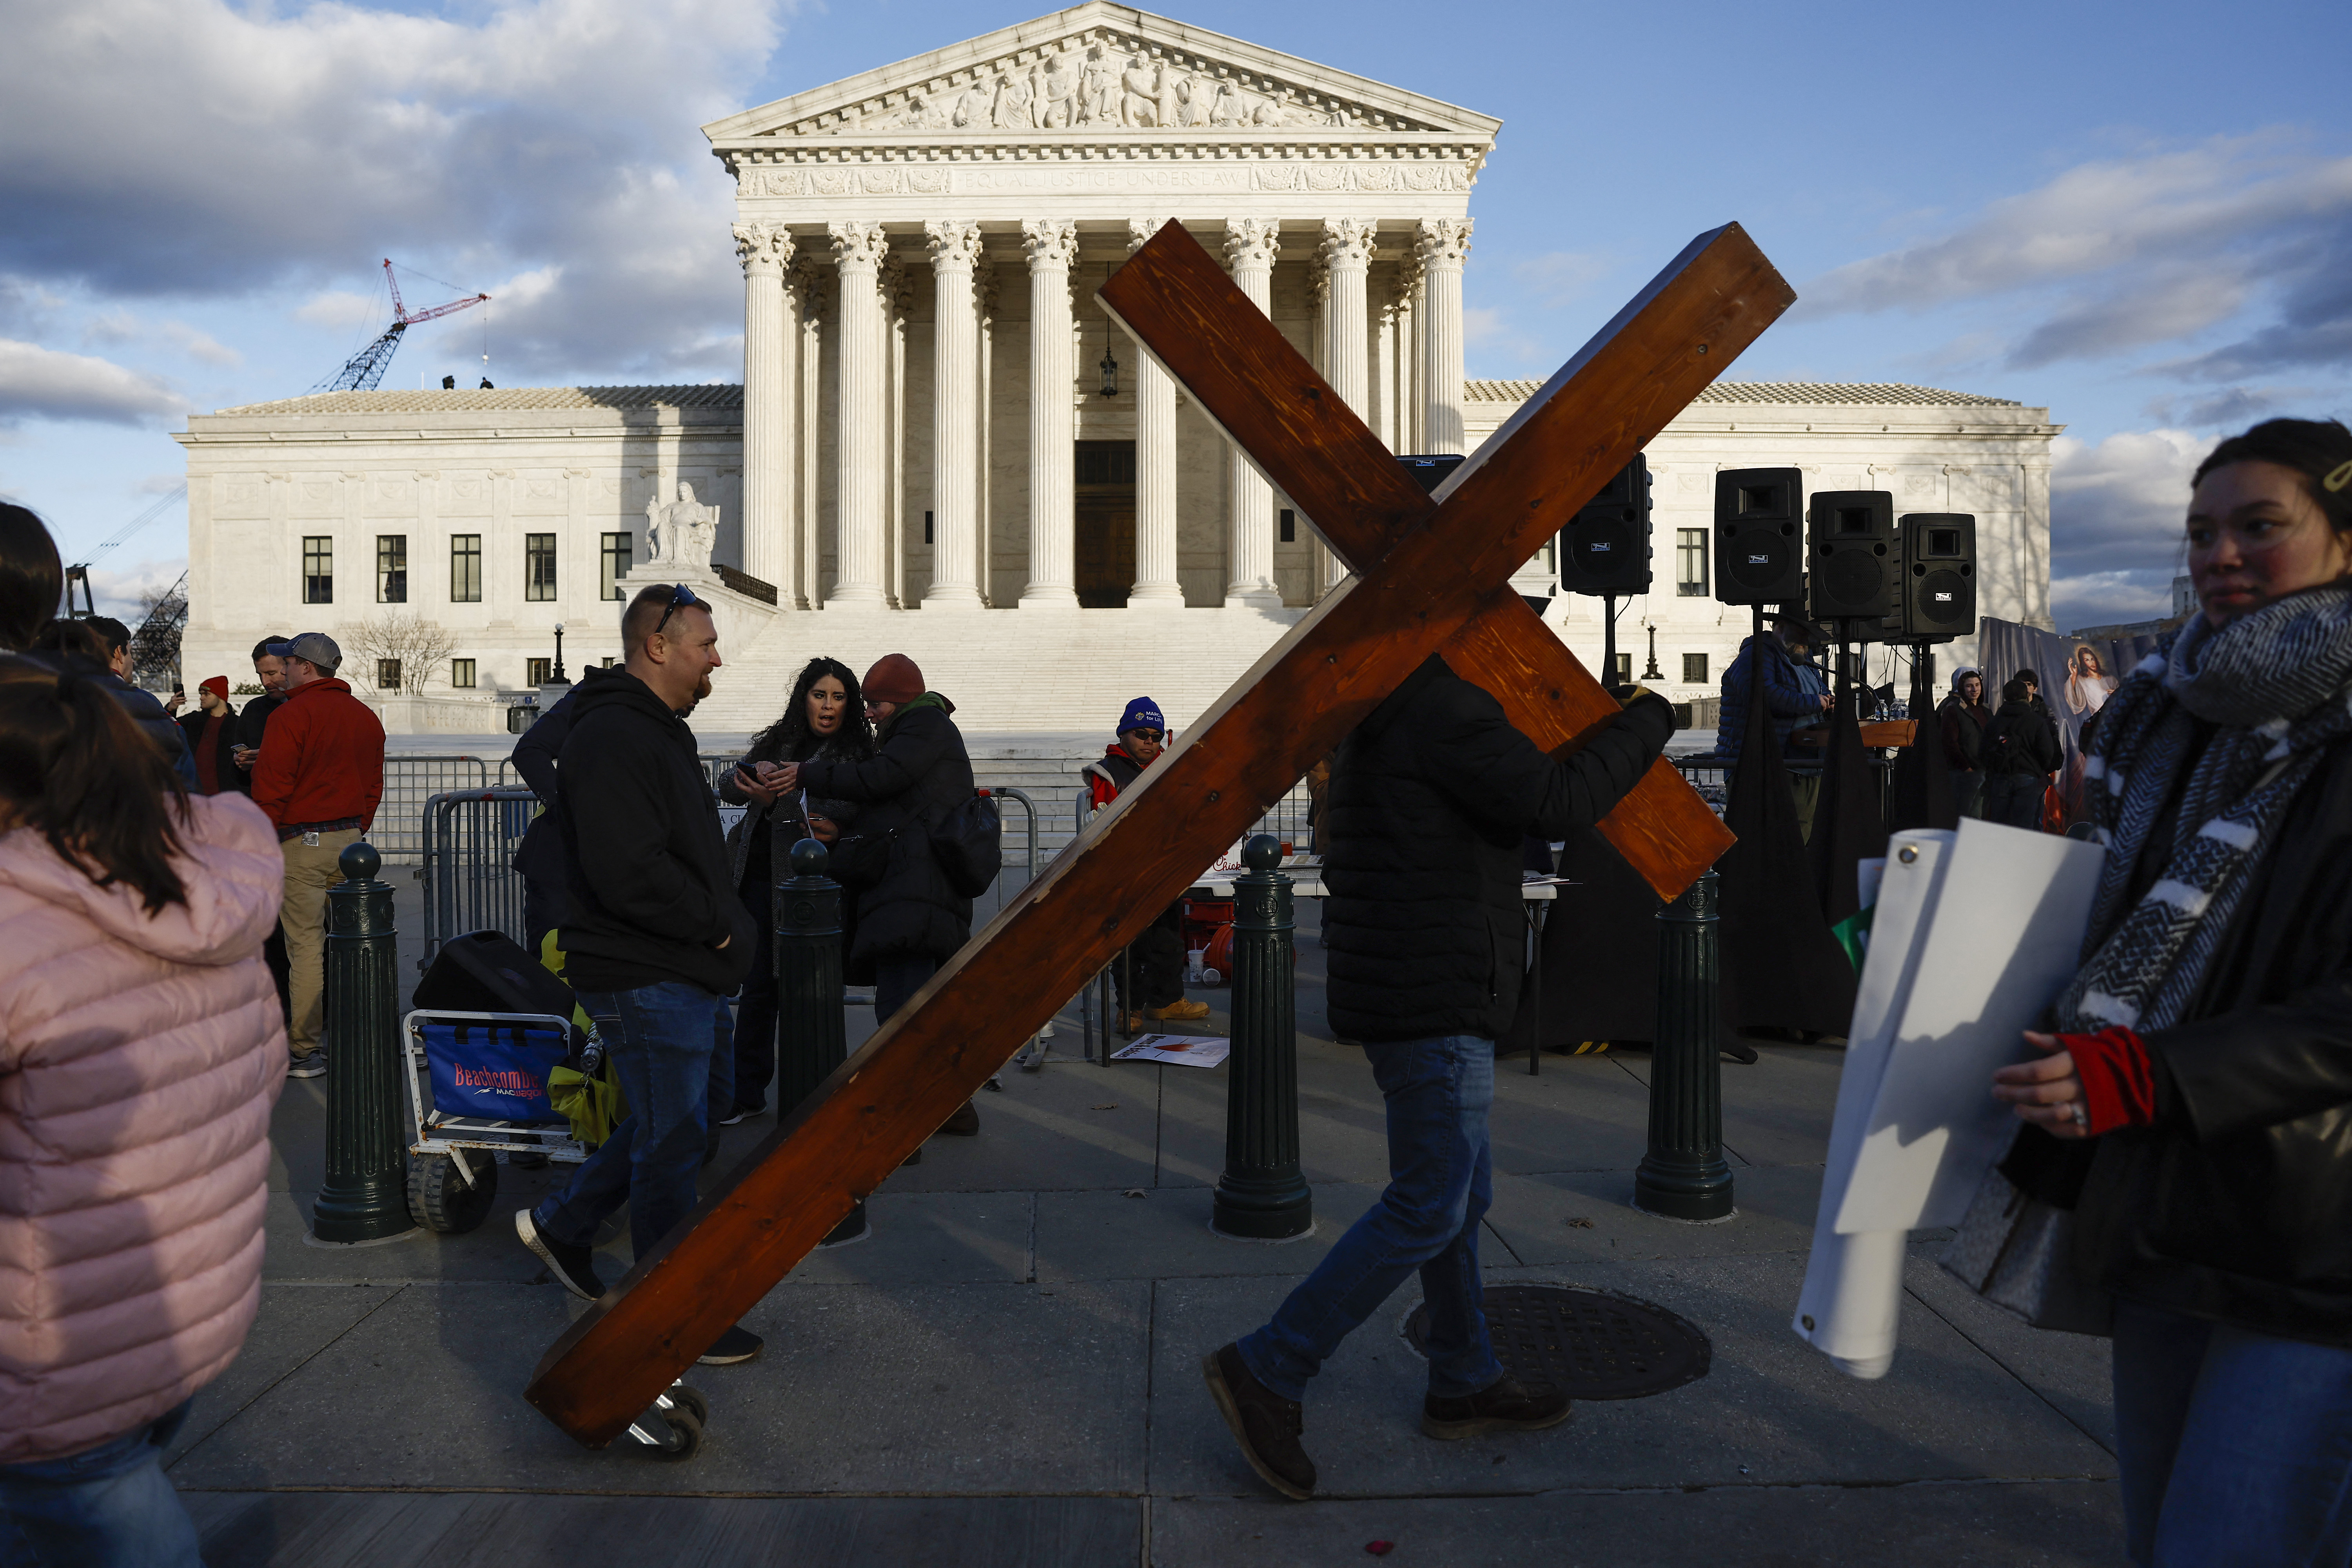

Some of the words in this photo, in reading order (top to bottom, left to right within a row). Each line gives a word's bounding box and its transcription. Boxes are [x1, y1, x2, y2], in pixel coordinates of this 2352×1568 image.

[965, 173, 1034, 189] EQUAL
[1037, 172, 1115, 186] JUSTICE
[1126, 172, 1195, 185] UNDER
[1201, 172, 1240, 185] LAW
[1138, 1035, 1166, 1044] Moms
[1114, 1048, 1146, 1058] Babies
